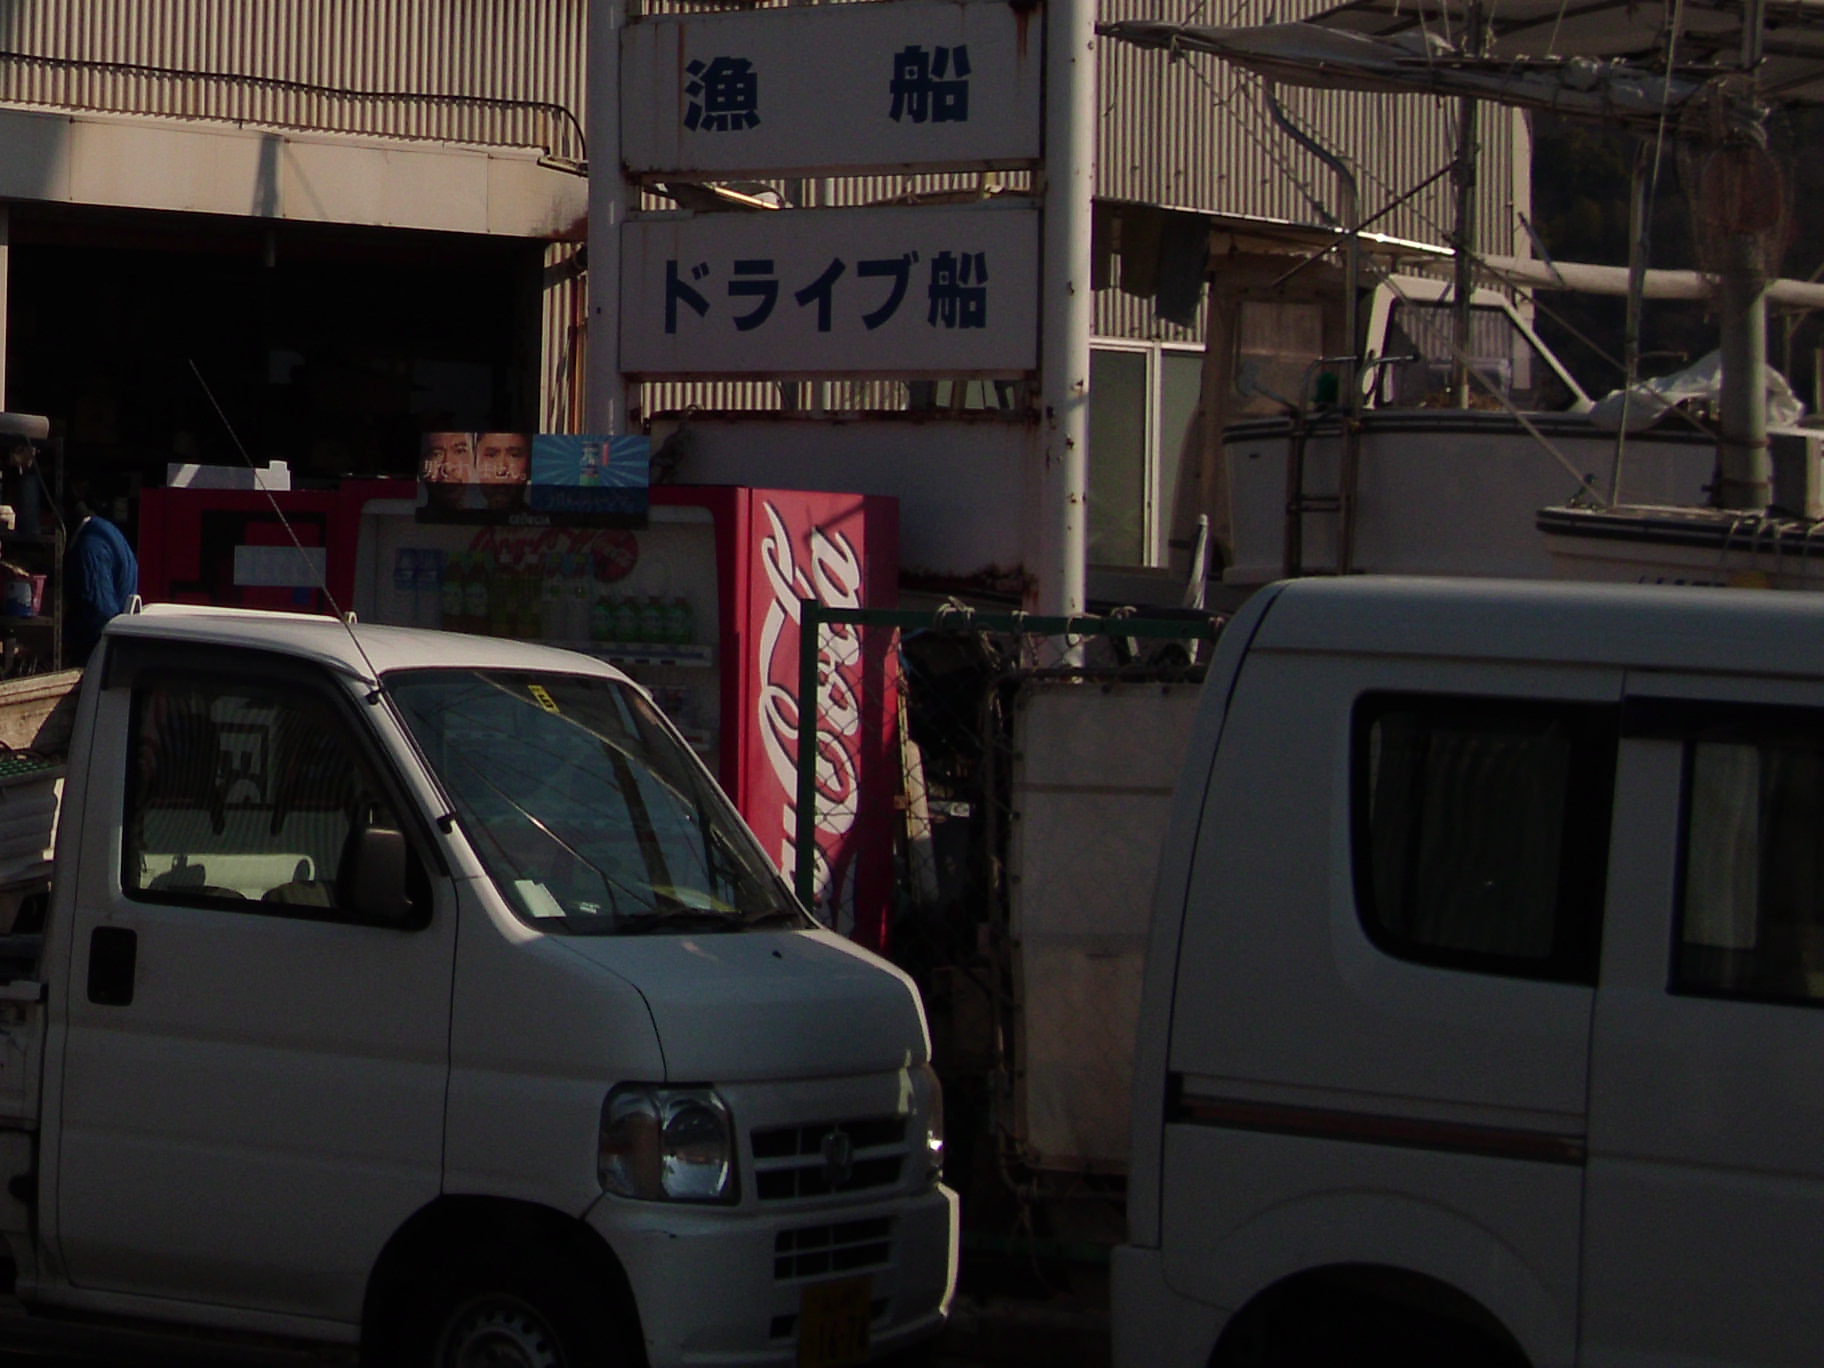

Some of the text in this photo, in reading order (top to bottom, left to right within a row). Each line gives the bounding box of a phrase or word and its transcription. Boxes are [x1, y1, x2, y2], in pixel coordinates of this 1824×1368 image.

[665, 251, 989, 334] ドライブ船
